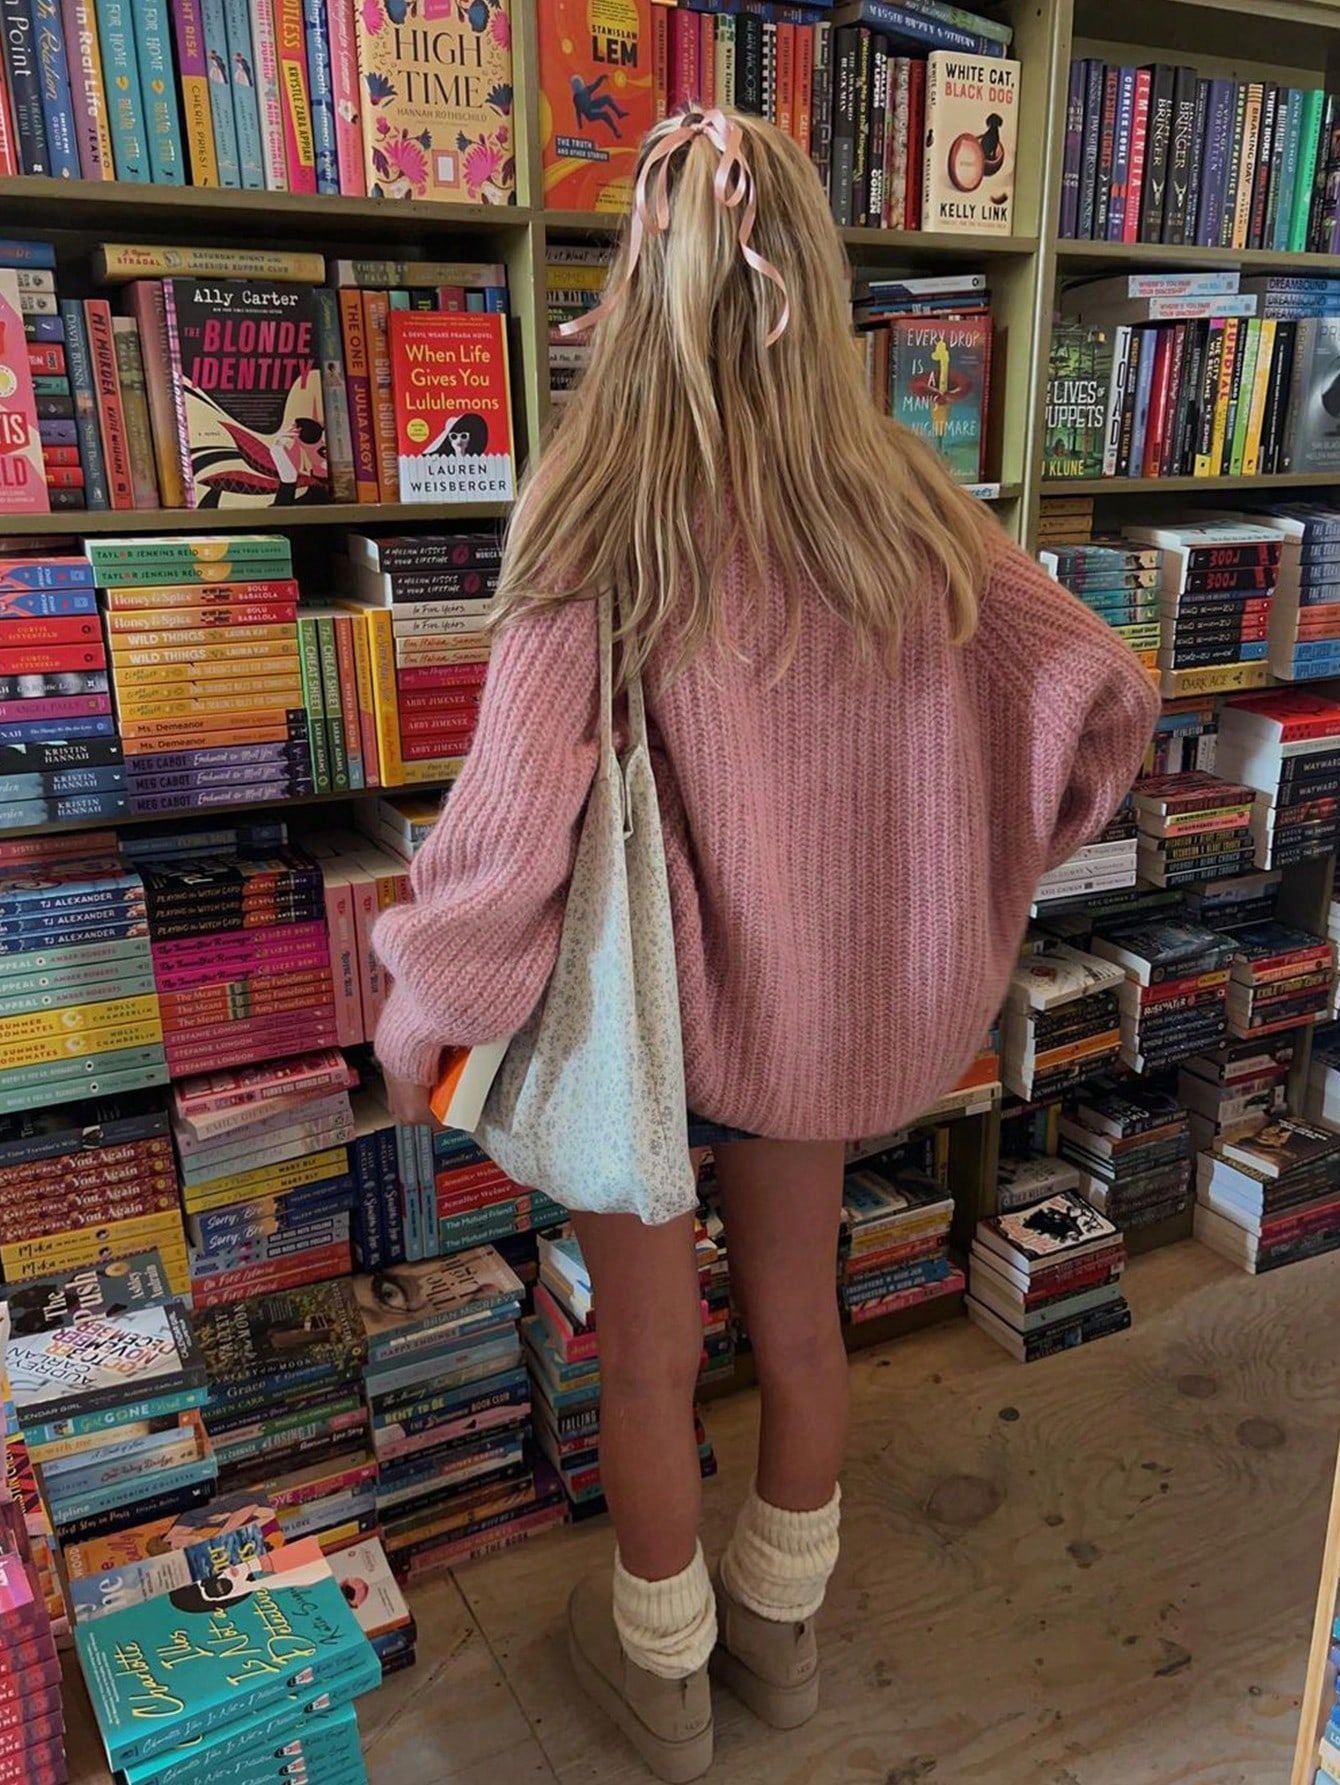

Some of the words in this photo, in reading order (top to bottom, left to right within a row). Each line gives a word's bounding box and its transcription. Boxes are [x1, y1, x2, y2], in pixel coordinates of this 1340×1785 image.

[184, 25, 198, 57] RISK
[591, 24, 638, 40] STANISLAW
[7, 16, 31, 77] Point
[78, 32, 96, 74] Real
[394, 28, 483, 67] HIGH
[592, 35, 638, 68] LEM
[725, 48, 733, 71] White
[945, 63, 984, 83] WHITE
[84, 77, 100, 117] Life
[398, 70, 484, 109] TIME
[724, 74, 732, 106] Elephant
[945, 82, 984, 100] BLACK
[989, 85, 1013, 104] DOG
[191, 85, 203, 126] CHERIE
[1121, 76, 1132, 123] CHARLES
[1266, 90, 1276, 125] WHITE
[288, 66, 301, 102] KRYSTLE
[299, 129, 313, 161] APPIAH
[397, 109, 433, 118] HANNAH
[434, 110, 488, 122] ROTHSCHILD
[1130, 74, 1151, 193] FEMLANDIA
[1152, 97, 1166, 167] BRINGER
[1175, 101, 1189, 170] BRINGER
[88, 128, 100, 163] JEAN
[195, 131, 208, 168] PRIEST
[557, 137, 570, 147] THE
[571, 138, 592, 149] TRUTH
[1262, 127, 1272, 162] HORSE
[1229, 144, 1239, 195] PRACTICE
[1244, 162, 1253, 184] DAY
[940, 203, 976, 220] KELLY
[981, 204, 1008, 221] LINK
[187, 262, 229, 272] LAKESIDE
[231, 264, 266, 273] SUPPER
[268, 265, 289, 273] CLUB
[193, 288, 237, 306] Ally
[242, 290, 299, 306] Carter
[66, 313, 79, 348] DAVIS
[91, 311, 106, 334] MY
[184, 327, 200, 337] THE
[203, 319, 313, 354] BLONDE
[907, 328, 945, 347] EVERY
[950, 331, 980, 348] DROP
[348, 336, 363, 369] ONE
[406, 344, 456, 363] When
[460, 344, 491, 362] Life
[1220, 322, 1237, 399] SUNDIAL
[71, 352, 85, 387] BUNN
[96, 338, 116, 396] MURDER
[191, 357, 314, 389] IDENTITY
[912, 359, 924, 375] IS
[411, 369, 457, 387] Gives
[459, 371, 490, 387] You
[1052, 380, 1097, 404] LIVES
[354, 384, 369, 429] JULIA
[405, 393, 499, 411] Lululemons
[902, 395, 938, 412] MAN'S
[359, 432, 373, 473] ARGY
[427, 464, 488, 476] LAUREN
[1049, 459, 1084, 476] KLUNE
[410, 480, 507, 493] WEISBERGER
[96, 550, 134, 559] TAYLOR
[136, 548, 173, 558] JENKINS
[177, 548, 198, 557] REID
[102, 569, 138, 580] TAYLOR
[141, 568, 178, 578] JENKINS
[182, 568, 203, 578] REID
[237, 592, 278, 600] BABALOLA
[247, 585, 268, 593] BOLU
[113, 592, 150, 609] Honey
[161, 591, 192, 605] Spice
[421, 604, 439, 614] Five
[441, 604, 466, 614] Years
[113, 615, 150, 630] Honey
[161, 612, 192, 627] Spice
[237, 614, 278, 622] BABALOLA
[128, 632, 158, 646] WILD
[162, 630, 206, 643] THINGS
[419, 638, 449, 648] Italian
[129, 651, 160, 664] WILD
[164, 648, 207, 661] THINGS
[406, 699, 430, 708] ABBY
[431, 696, 466, 706] JIMENEZ
[138, 724, 154, 734] Ms.
[156, 721, 204, 732] Demeanor
[44, 746, 88, 756] KRISTIN
[158, 737, 206, 748] Demeanor
[44, 752, 90, 764] HANNAH
[158, 756, 188, 770] CABOT
[1303, 759, 1340, 772] WAYWARD
[53, 774, 96, 784] KRISTIN
[53, 780, 98, 790] HANNAH
[1299, 781, 1338, 796] WAYWARD
[40, 900, 52, 909] TJ
[55, 892, 113, 907] ALEXANDER
[43, 917, 54, 927] TJ
[57, 910, 115, 925] ALEXANDER
[58, 927, 116, 943] ALEXANDER
[92, 1007, 152, 1022] CHAMBERLIN
[107, 1002, 136, 1012] HOLLY
[96, 1031, 155, 1048] CHAMBERLIN
[110, 1027, 140, 1037] HOLLY
[68, 1155, 96, 1169] You,
[101, 1147, 135, 1164] Again
[72, 1173, 100, 1188] You,
[102, 1165, 138, 1182] Again
[105, 1184, 141, 1200] Again
[207, 1214, 239, 1230] Sorry,
[209, 1233, 240, 1249] Sorry,
[14, 1359, 98, 1385] AUDREY
[105, 1404, 149, 1424] GONE
[252, 1587, 316, 1665] Detective
[207, 1617, 262, 1658] Not
[114, 1641, 185, 1719] Charlotte
[226, 1659, 280, 1686] Is
